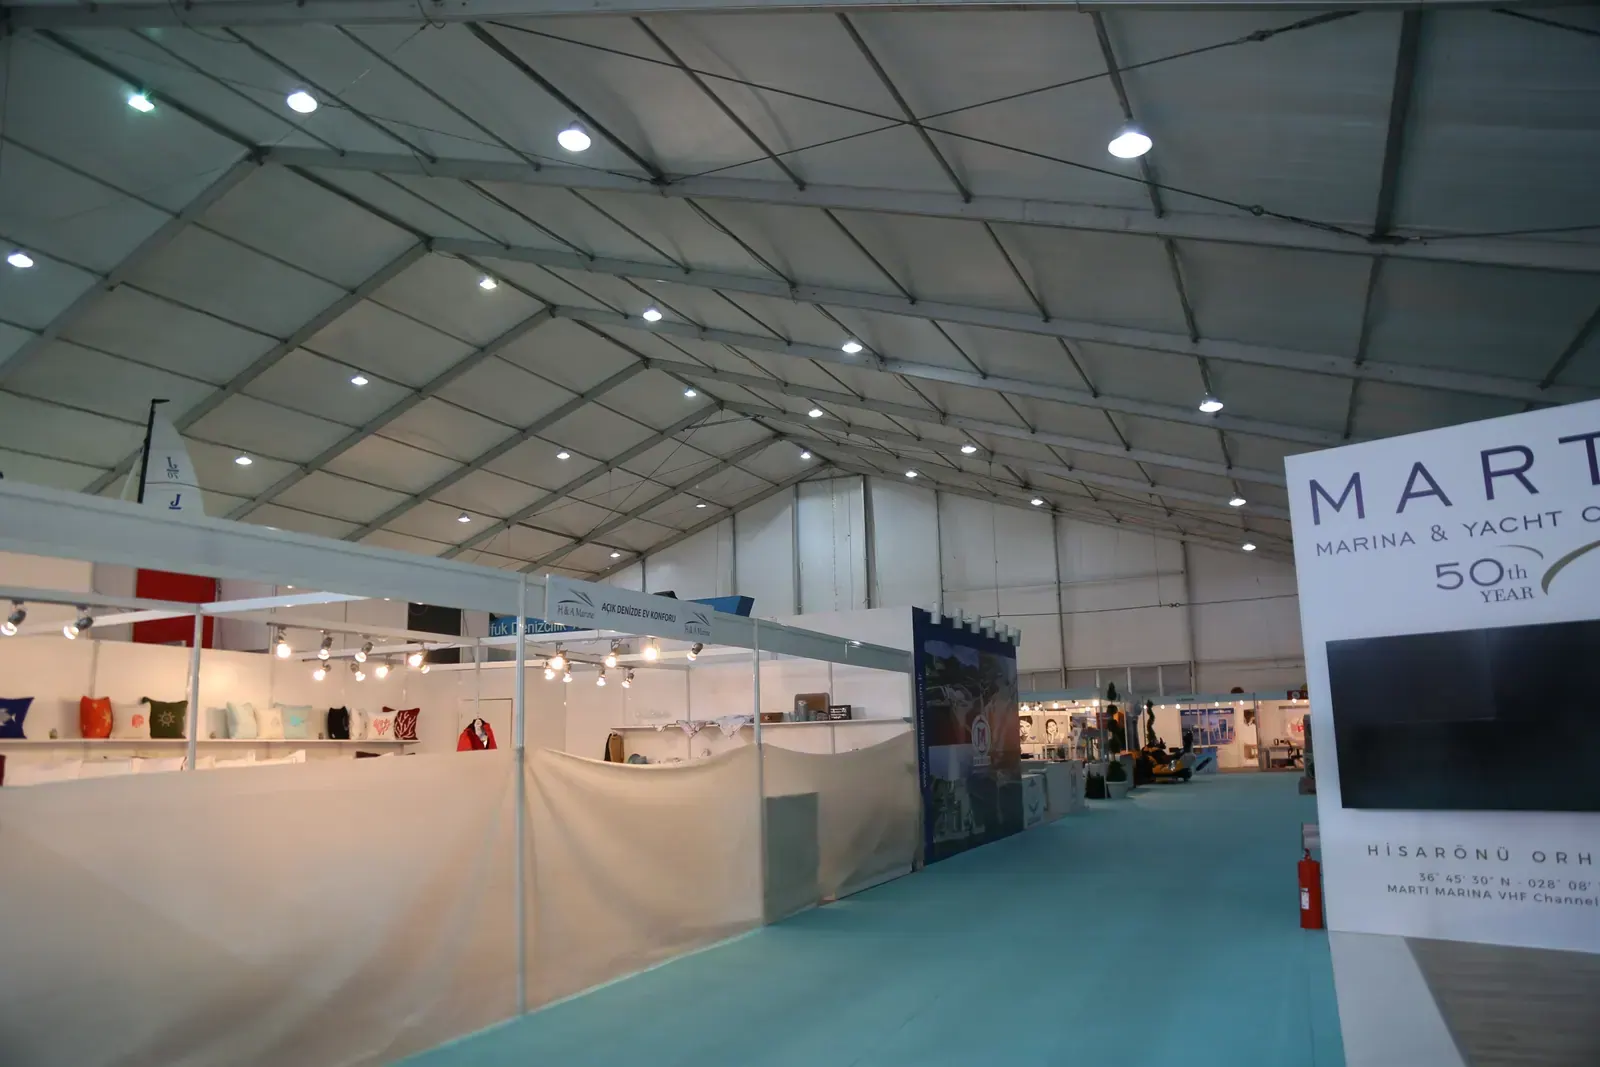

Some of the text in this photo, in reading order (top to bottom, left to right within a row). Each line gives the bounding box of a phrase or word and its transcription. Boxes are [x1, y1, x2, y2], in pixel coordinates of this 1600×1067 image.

[1316, 530, 1416, 557] MARINA
[1430, 524, 1449, 542] &
[1463, 509, 1563, 538] YACHT
[1434, 557, 1528, 591] 50th
[1479, 586, 1536, 604] YEAR
[642, 608, 650, 619] EV
[650, 610, 677, 623] KONFORU
[1367, 842, 1593, 866] HİSARÖNÜ ORH
[1500, 876, 1510, 887] N
[1387, 883, 1600, 907] MARTI MARINA VHF Channel
